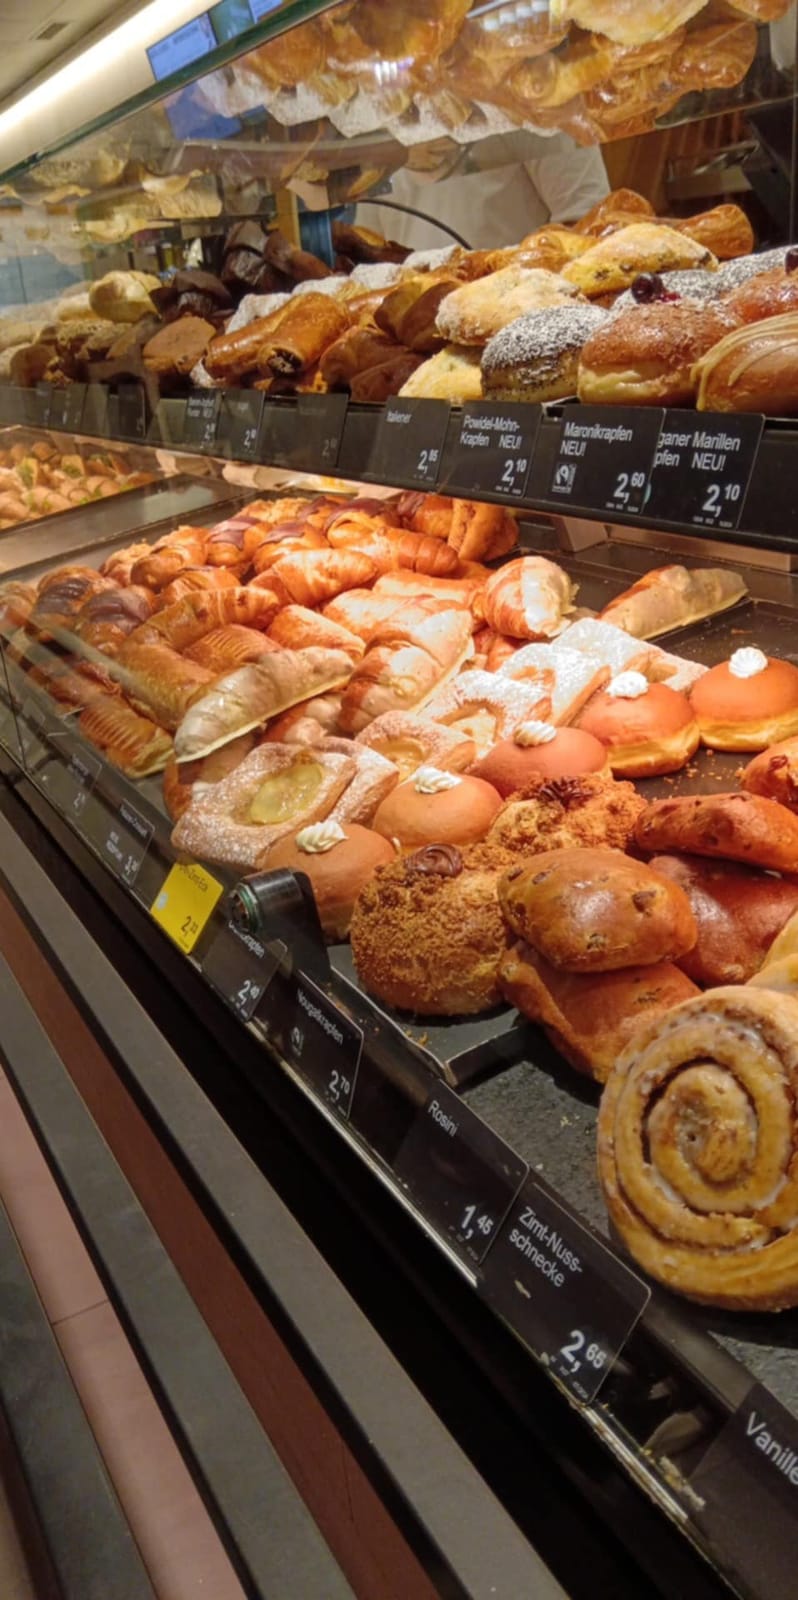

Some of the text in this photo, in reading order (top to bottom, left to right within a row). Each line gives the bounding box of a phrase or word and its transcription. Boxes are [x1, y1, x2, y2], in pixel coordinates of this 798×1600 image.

[463, 415, 521, 432] Powidel-Mohn-
[563, 422, 633, 443] Maronikrapfen
[460, 431, 523, 450] Krapfen NEU!
[560, 440, 587, 457] NEU!
[691, 431, 741, 451] Marillen
[691, 452, 726, 471] NEU!
[428, 1100, 460, 1137] Rosini
[519, 1206, 583, 1273] Zimt-Nuss-
[508, 1228, 565, 1288] schnecke
[746, 1411, 798, 1485] Vanille
